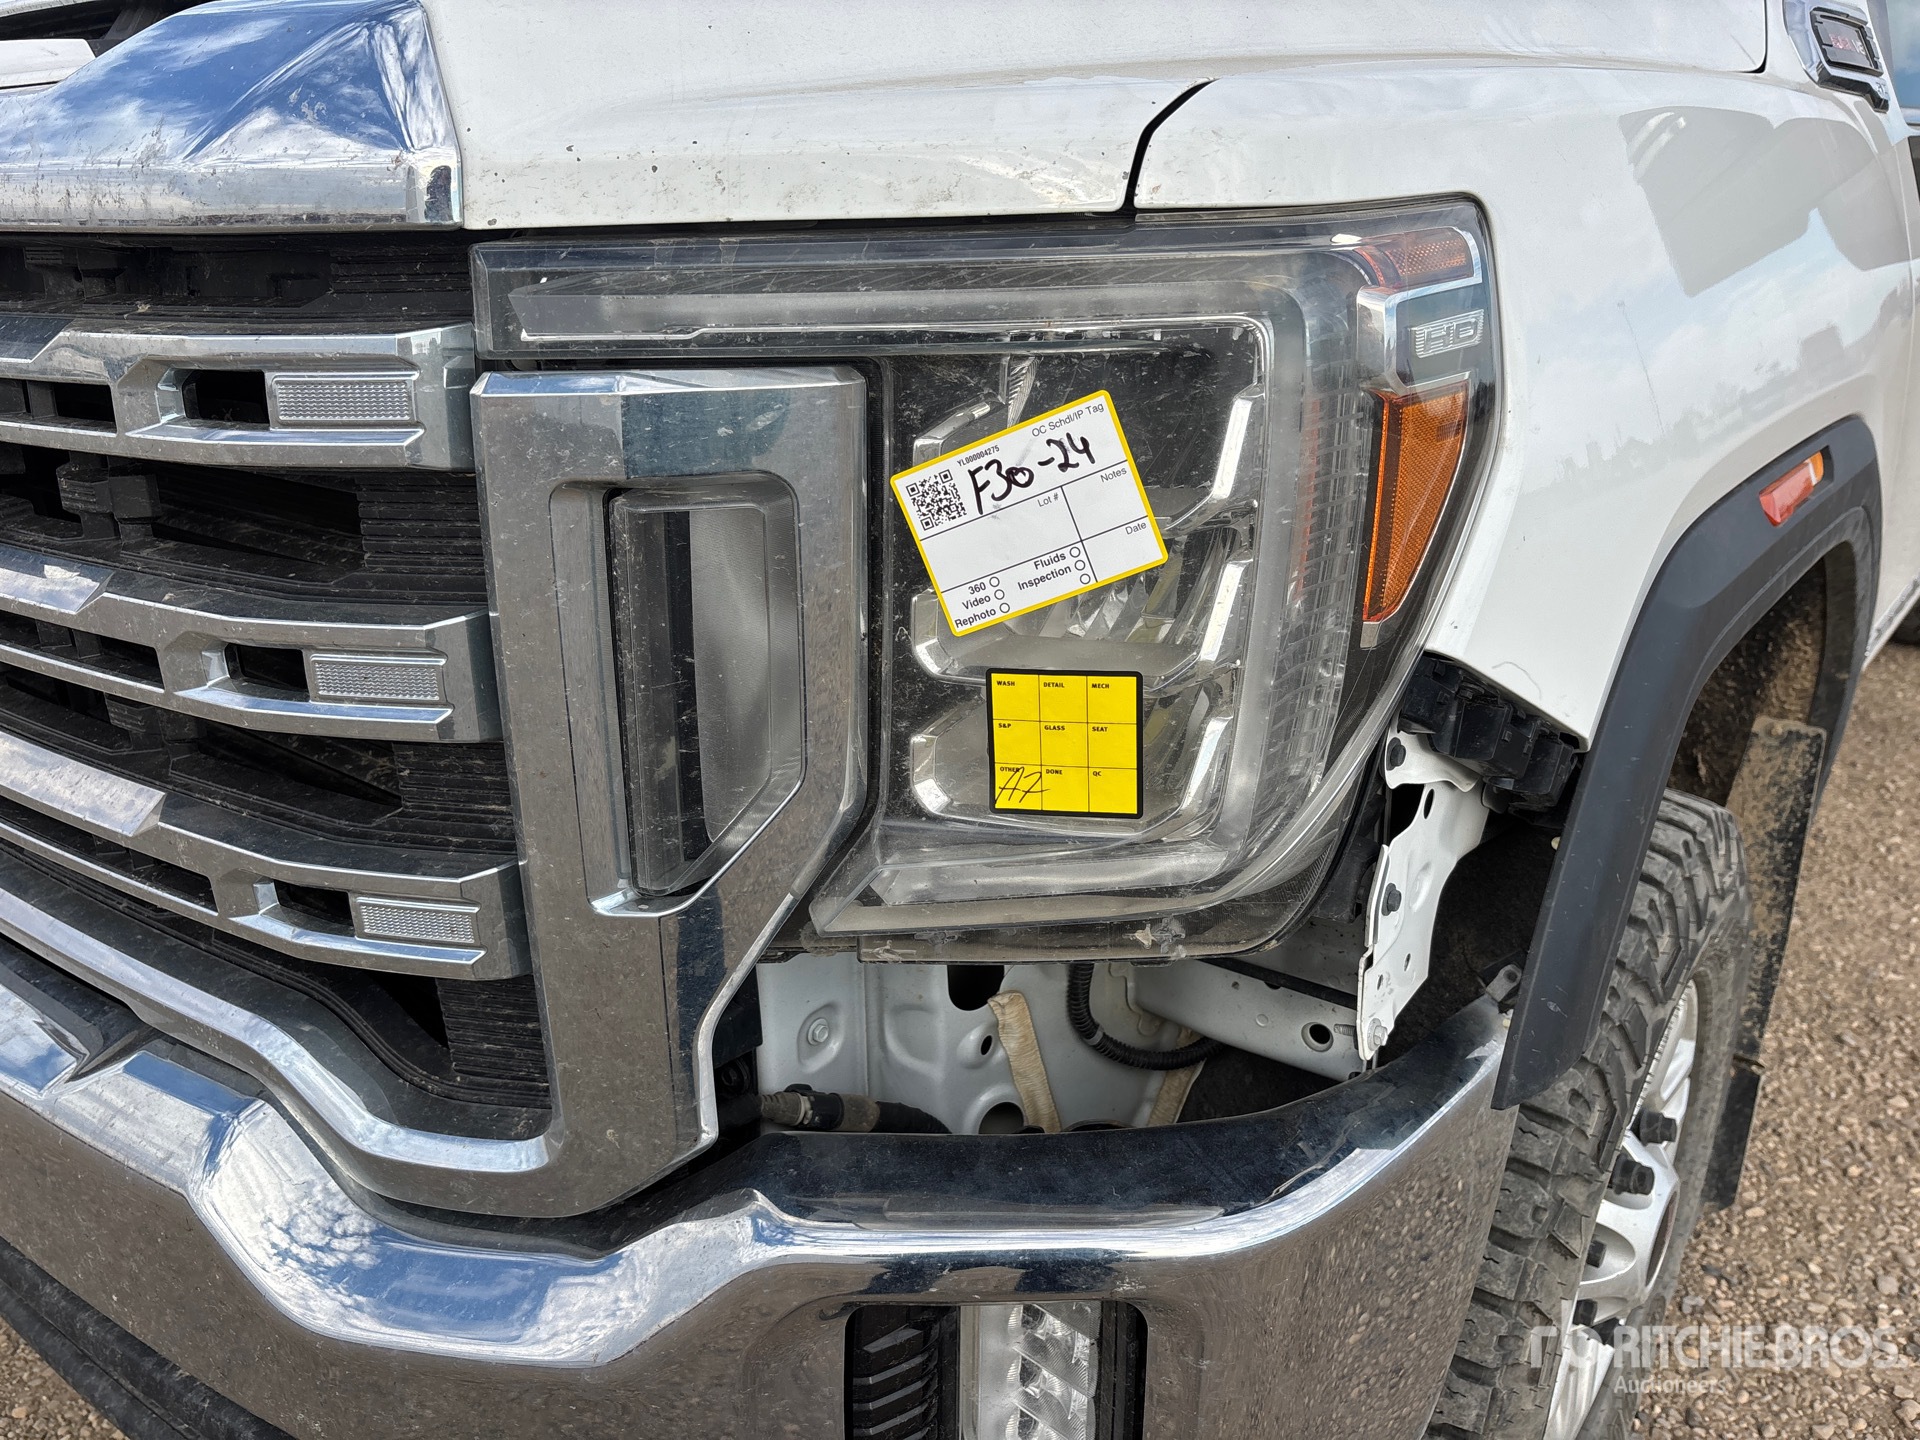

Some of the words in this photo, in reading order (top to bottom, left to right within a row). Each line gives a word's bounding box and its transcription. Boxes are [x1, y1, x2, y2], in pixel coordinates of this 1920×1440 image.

[1031, 424, 1048, 437] OC
[1086, 402, 1105, 416] Tag
[957, 445, 1000, 466] YL000004275
[1100, 467, 1128, 483] Notes
[1037, 497, 1051, 508] Lot
[1125, 521, 1147, 536] Date
[1033, 552, 1067, 571] Fluids
[1017, 564, 1072, 591] Inspection
[968, 581, 987, 596] 360
[962, 594, 991, 611] Video
[954, 607, 997, 629] Rephoto
